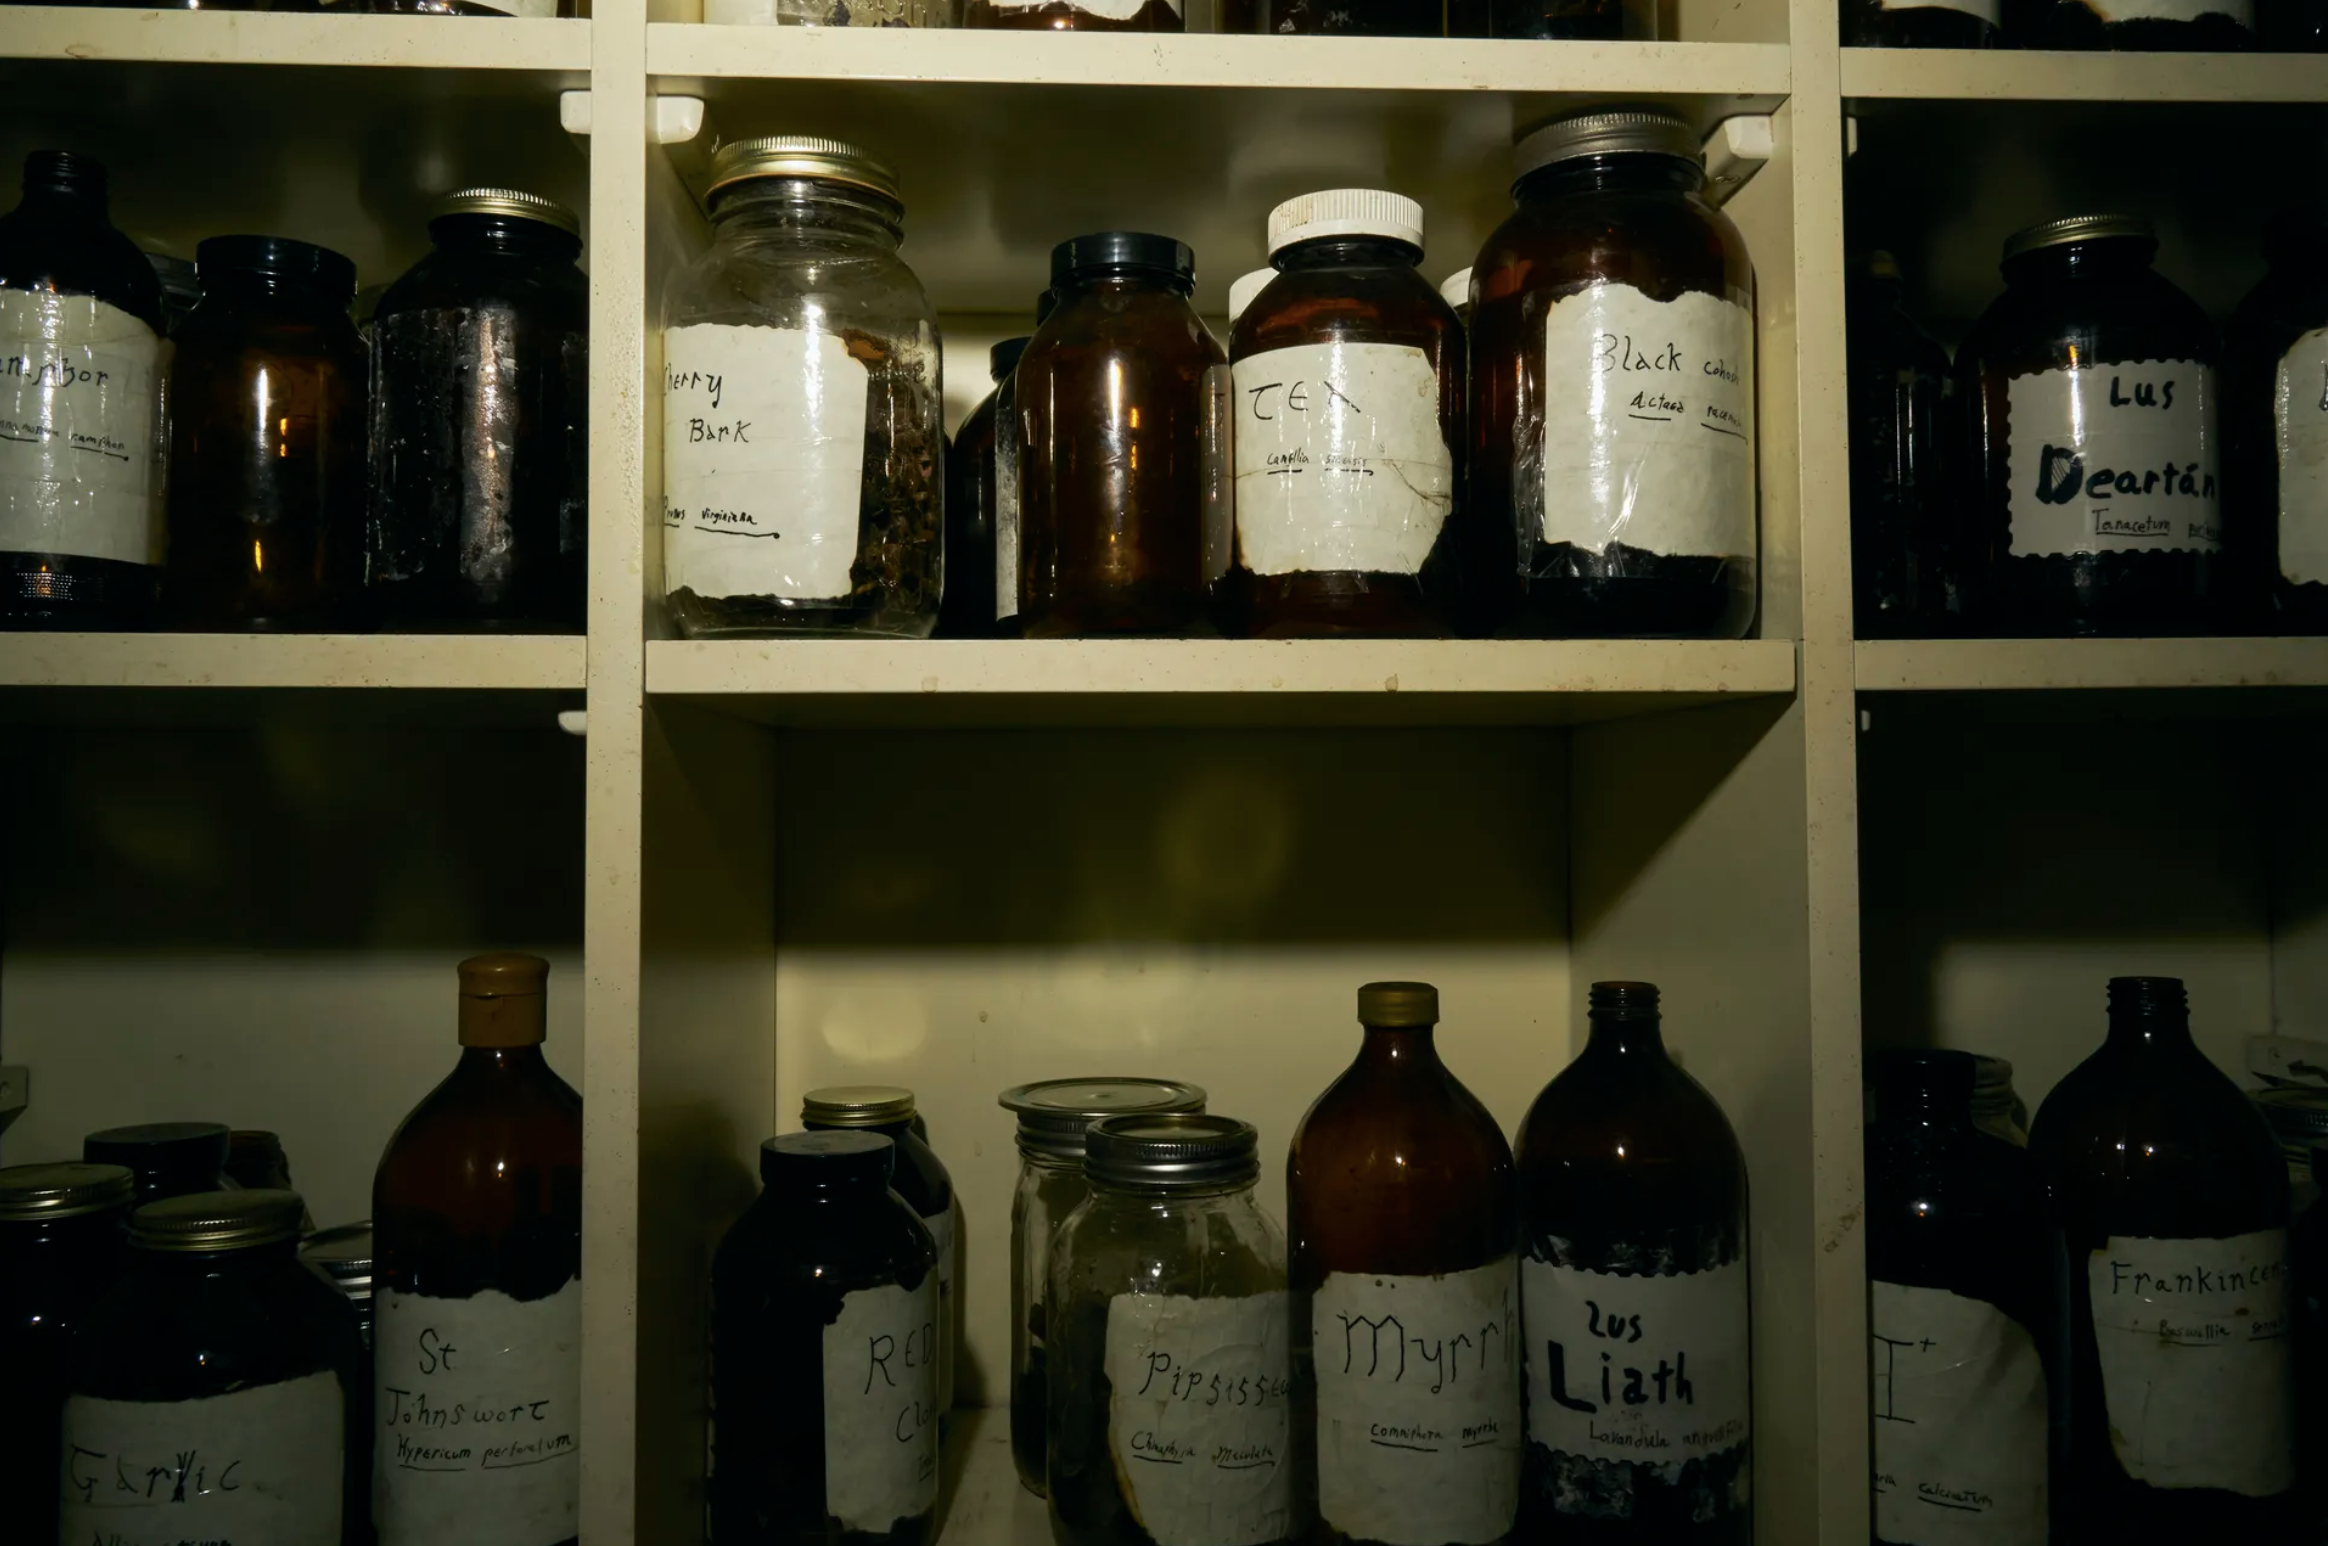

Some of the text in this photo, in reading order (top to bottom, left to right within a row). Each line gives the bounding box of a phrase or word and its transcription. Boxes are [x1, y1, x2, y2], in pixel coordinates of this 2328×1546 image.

[1597, 333, 1682, 373] Black
[2108, 375, 2176, 411] Lus
[2035, 443, 2216, 506] Deartán
[419, 1328, 456, 1375] St
[864, 1322, 933, 1395] RED
[1548, 1339, 1694, 1413] Liath
